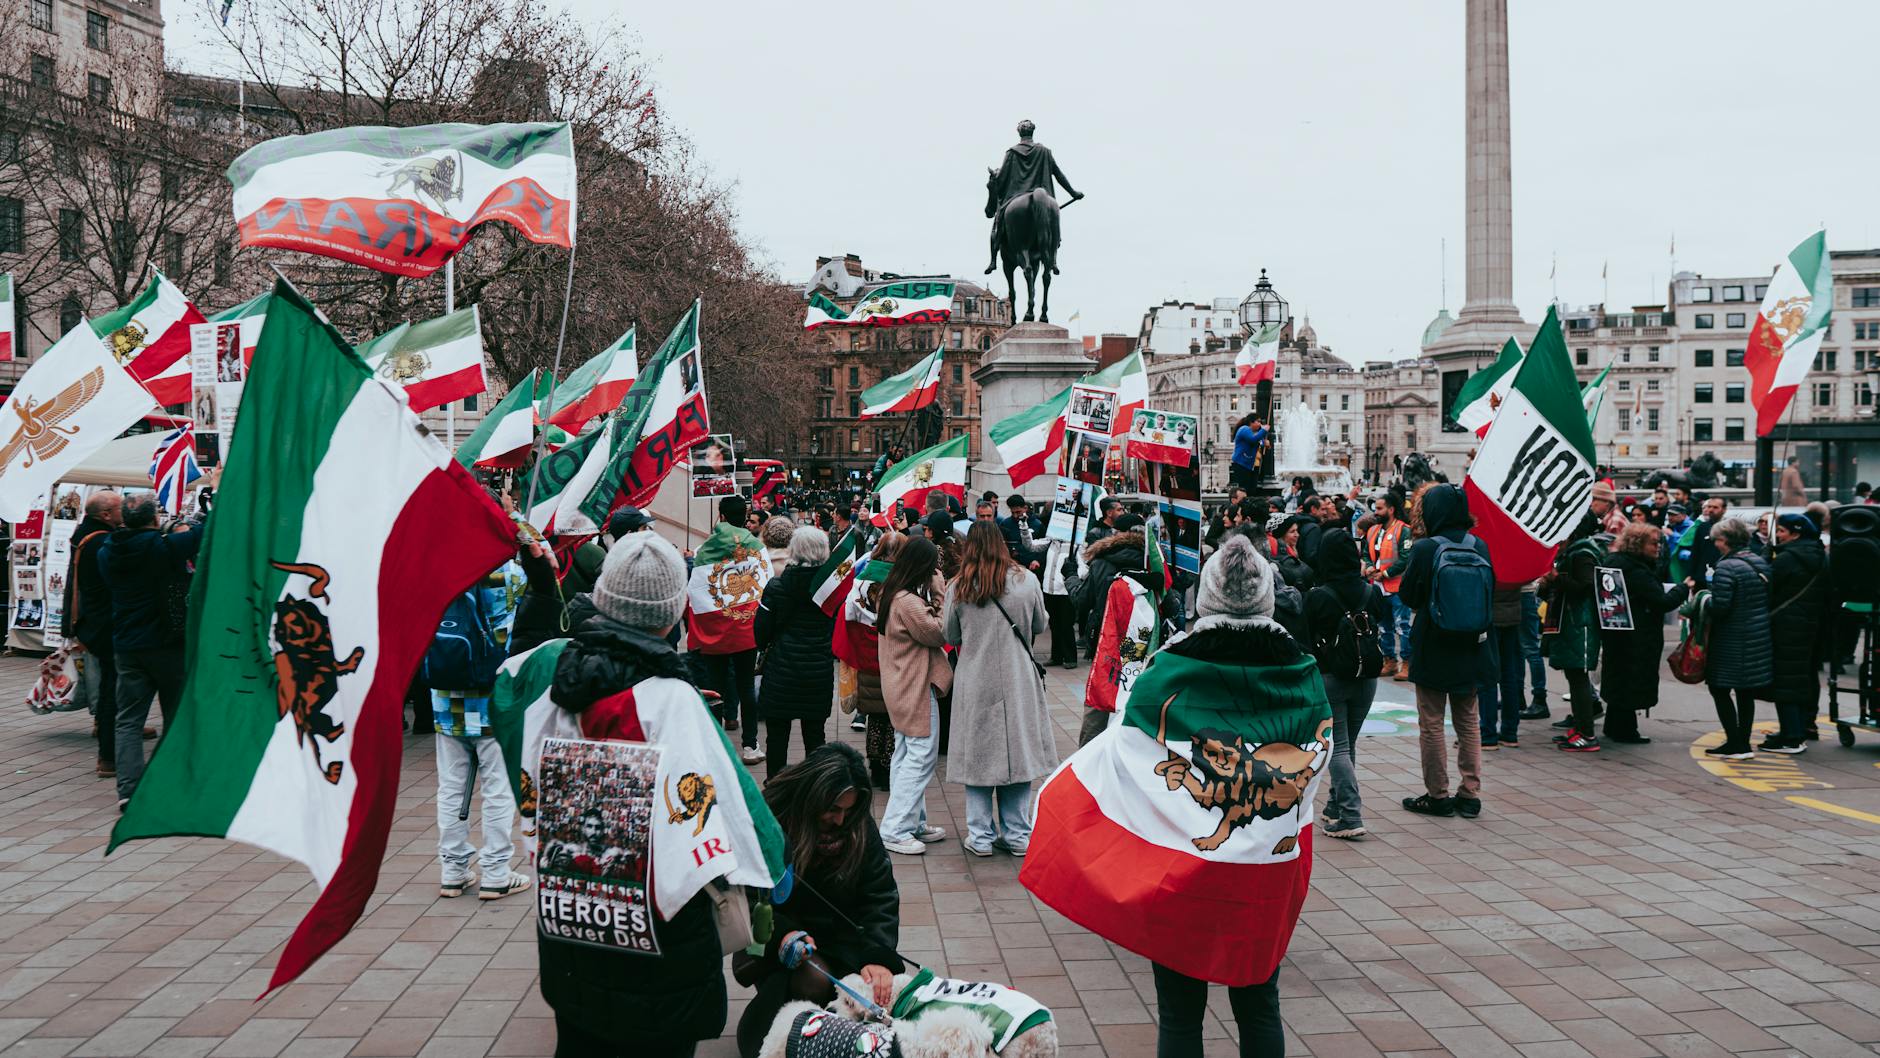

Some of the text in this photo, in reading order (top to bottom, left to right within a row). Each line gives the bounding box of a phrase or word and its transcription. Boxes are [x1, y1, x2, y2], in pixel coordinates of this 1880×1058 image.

[541, 894, 647, 932] HEROES
[544, 918, 652, 950] Never Die
